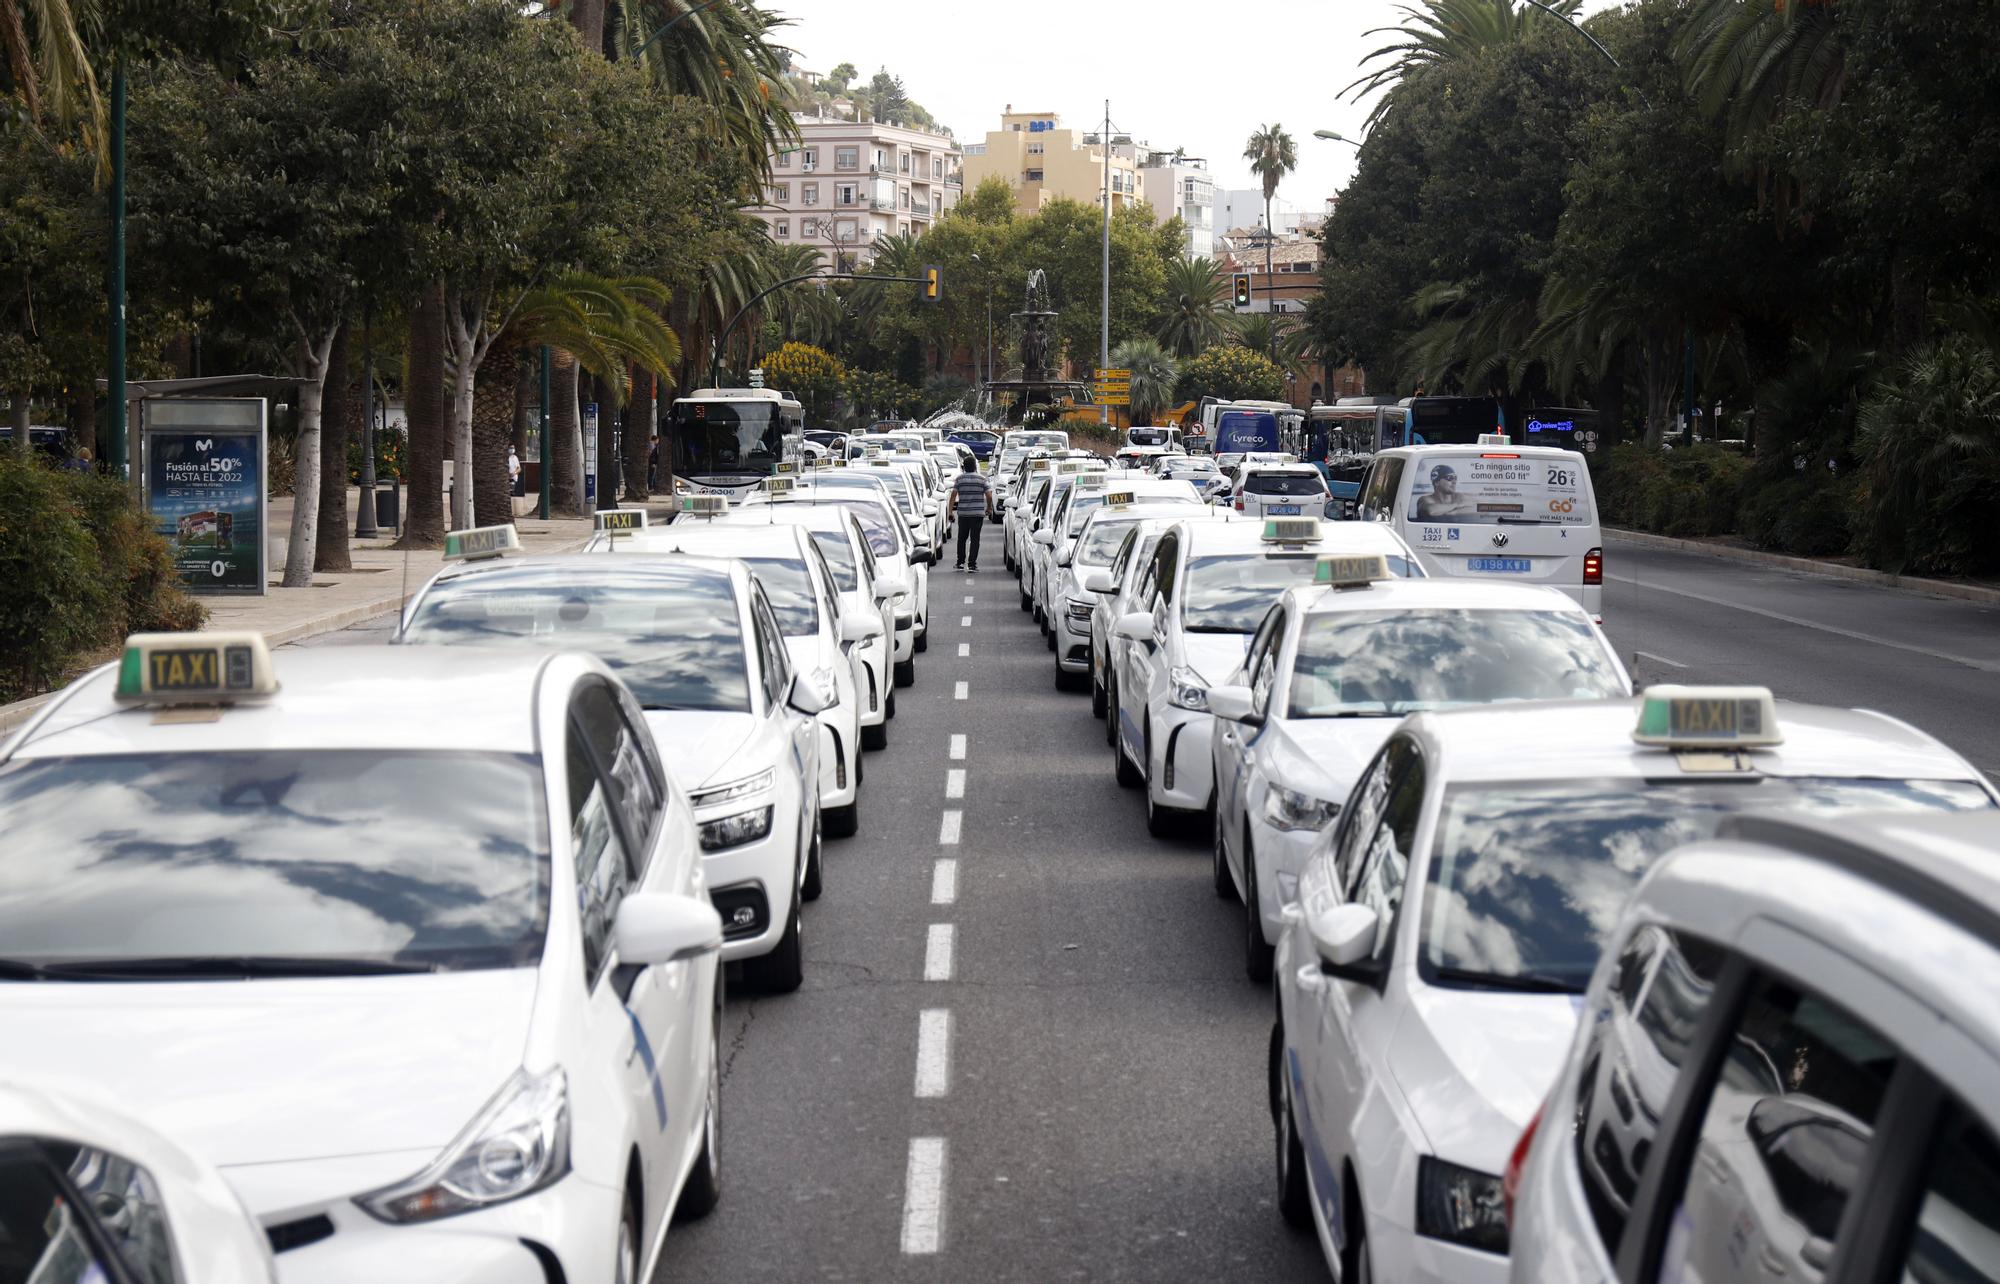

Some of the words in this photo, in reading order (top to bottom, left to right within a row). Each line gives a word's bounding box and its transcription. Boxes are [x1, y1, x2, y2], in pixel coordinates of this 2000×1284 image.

[1232, 434, 1264, 443] Lyreco
[166, 461, 199, 471] Fusión
[200, 462, 209, 471] al
[210, 457, 242, 472] 50%
[778, 464, 791, 472] TAXI
[1487, 463, 1513, 472] ningún
[166, 472, 200, 481] HASTA
[203, 472, 216, 482] EL
[218, 473, 242, 482] 2022
[1505, 472, 1516, 480] GO
[1547, 470, 1567, 486] 26
[768, 480, 786, 490] TAXI
[1110, 495, 1127, 504] TAXI
[1549, 500, 1572, 513] GO
[605, 514, 632, 528] TAXI
[1278, 522, 1301, 536] TAXI
[1561, 530, 1567, 538] X
[462, 532, 494, 550] TAXI
[1335, 558, 1365, 577] TAXI
[1475, 560, 1503, 570] 0198
[152, 653, 218, 686] TAXI
[1674, 699, 1733, 729] TAXI
